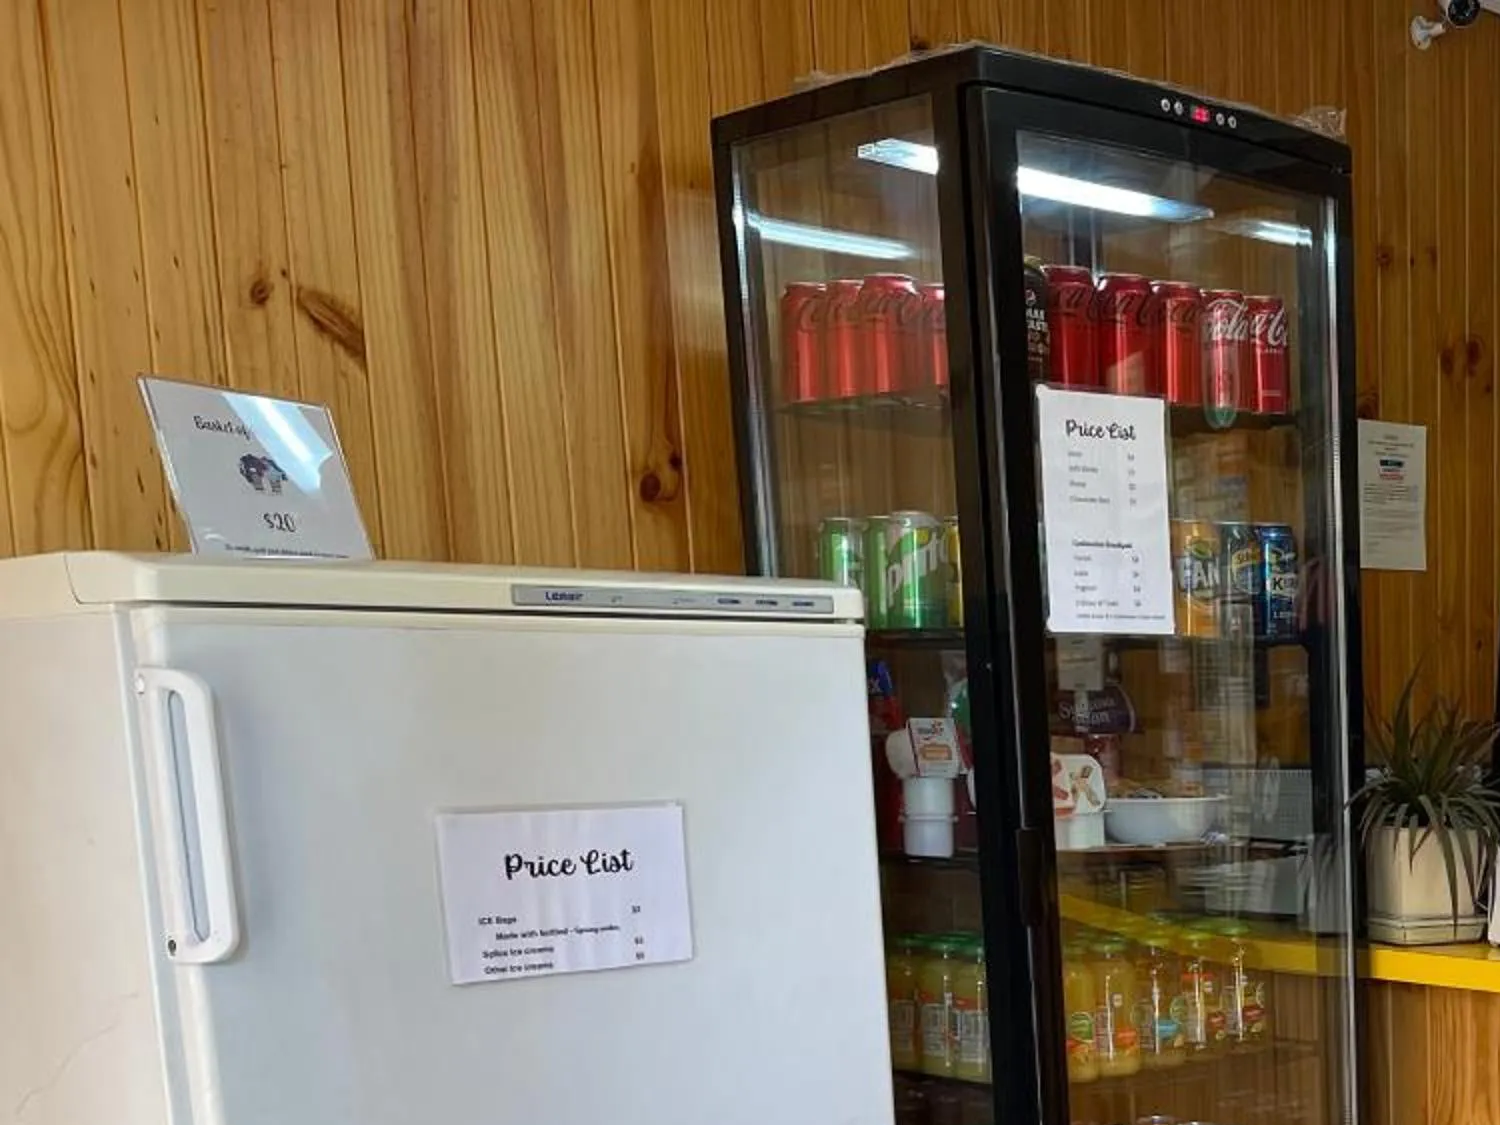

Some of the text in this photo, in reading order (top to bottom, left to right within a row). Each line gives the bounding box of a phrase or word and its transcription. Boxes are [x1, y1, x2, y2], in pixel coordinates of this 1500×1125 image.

[1065, 418, 1138, 442] Price List
[504, 847, 635, 881] Price List
[478, 917, 493, 926] ICE
[495, 931, 519, 941] Made
